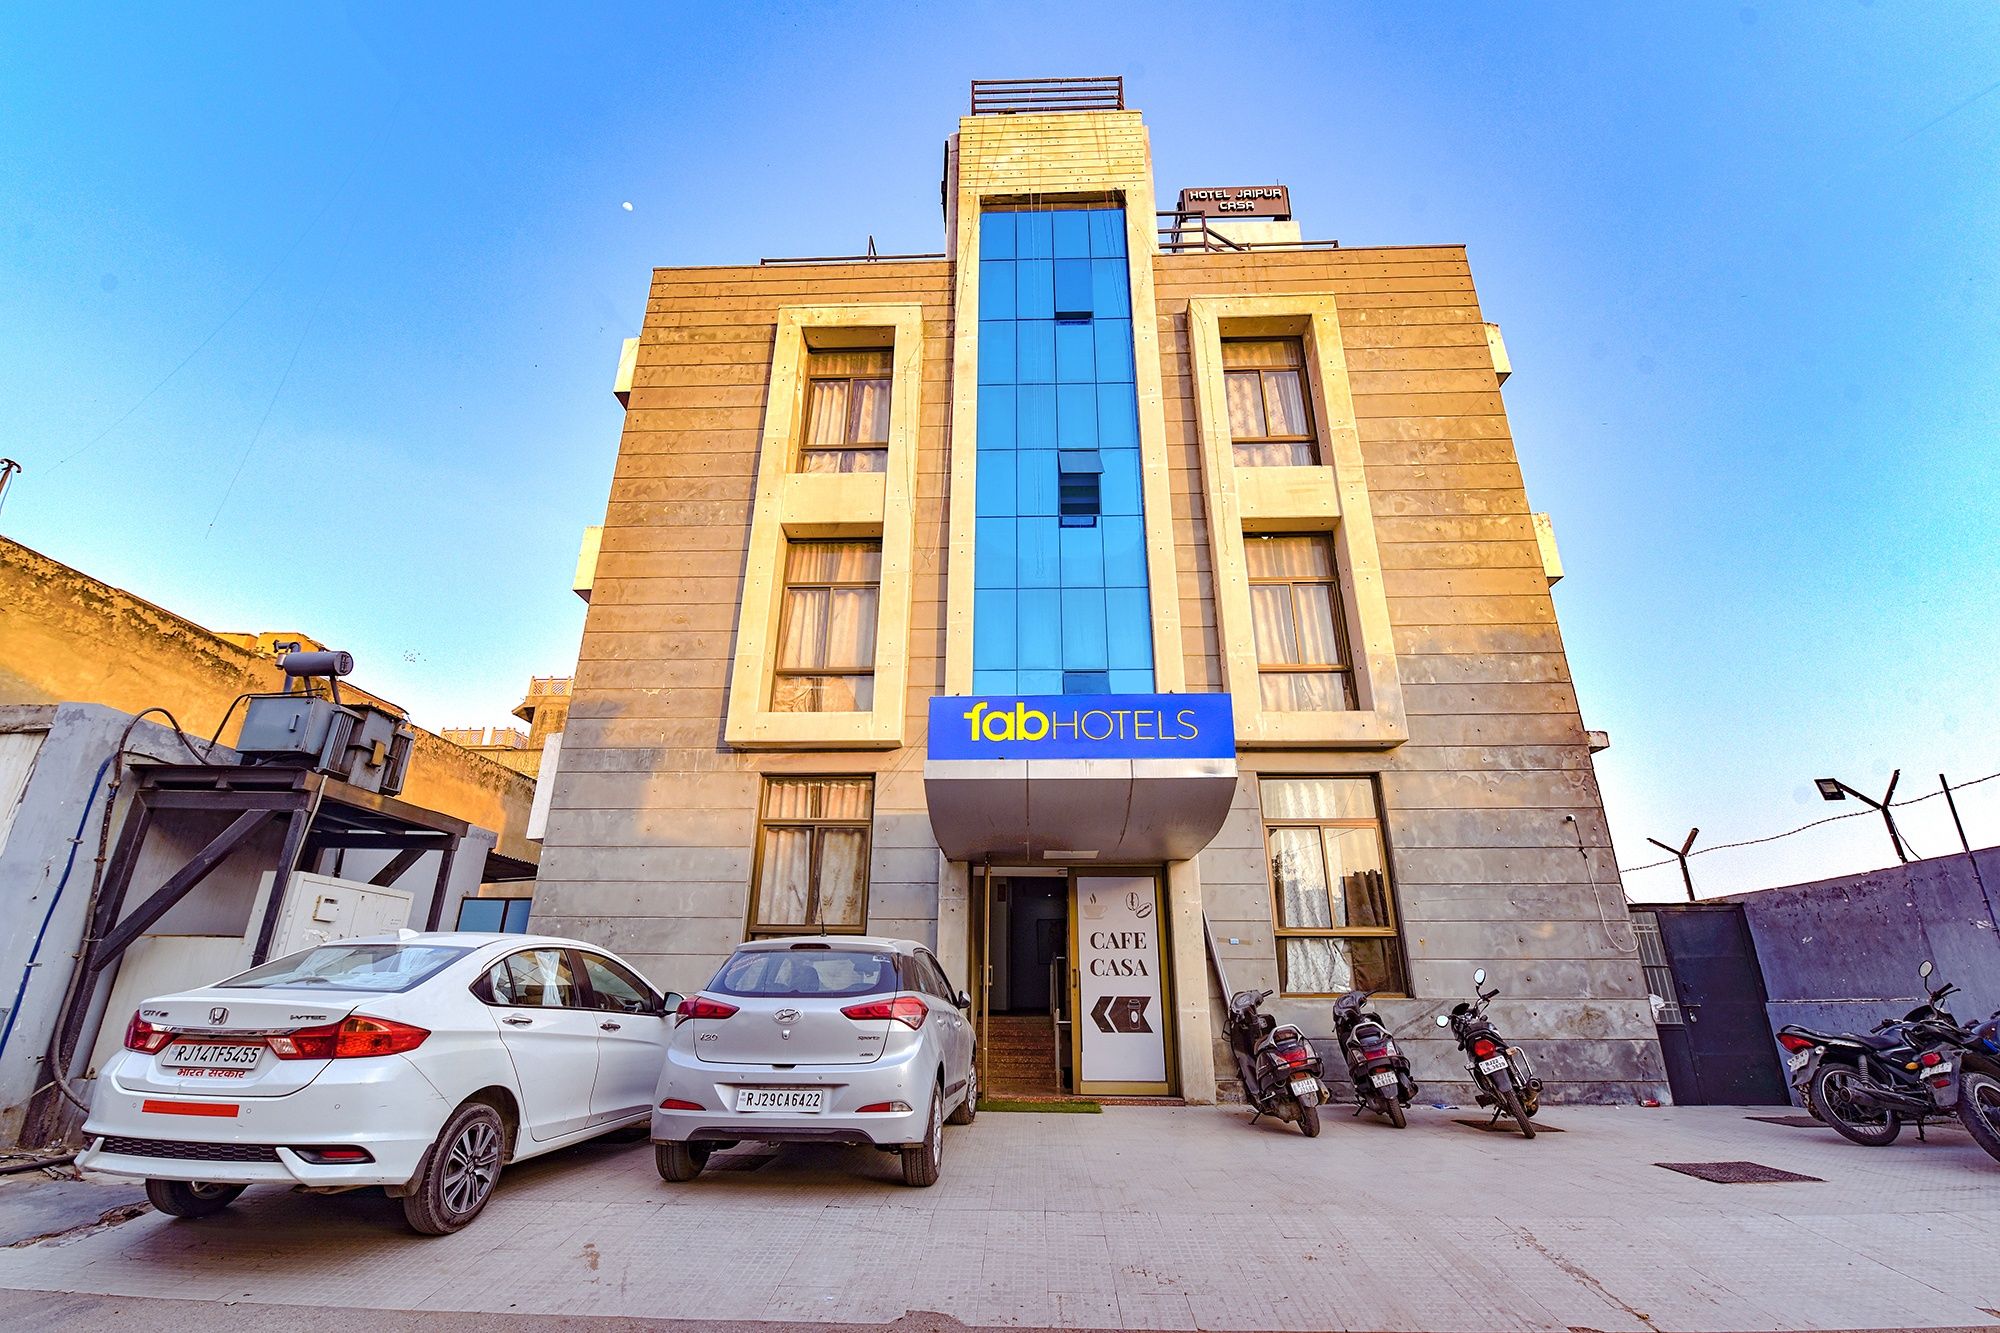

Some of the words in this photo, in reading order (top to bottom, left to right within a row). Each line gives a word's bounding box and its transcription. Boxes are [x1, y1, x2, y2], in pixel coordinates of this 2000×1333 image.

[1189, 189, 1231, 200] HOTEL
[1236, 188, 1282, 199] JAIPUR
[1219, 201, 1255, 211] CASA
[963, 701, 1199, 742] fabHOTELS
[1090, 931, 1147, 950] CAFE
[1090, 958, 1149, 977] CASA
[175, 1045, 261, 1064] RJ14TF5455
[177, 1068, 204, 1078] भारत
[208, 1069, 246, 1079] सरकार
[746, 1092, 821, 1107] RJ29CA6422
